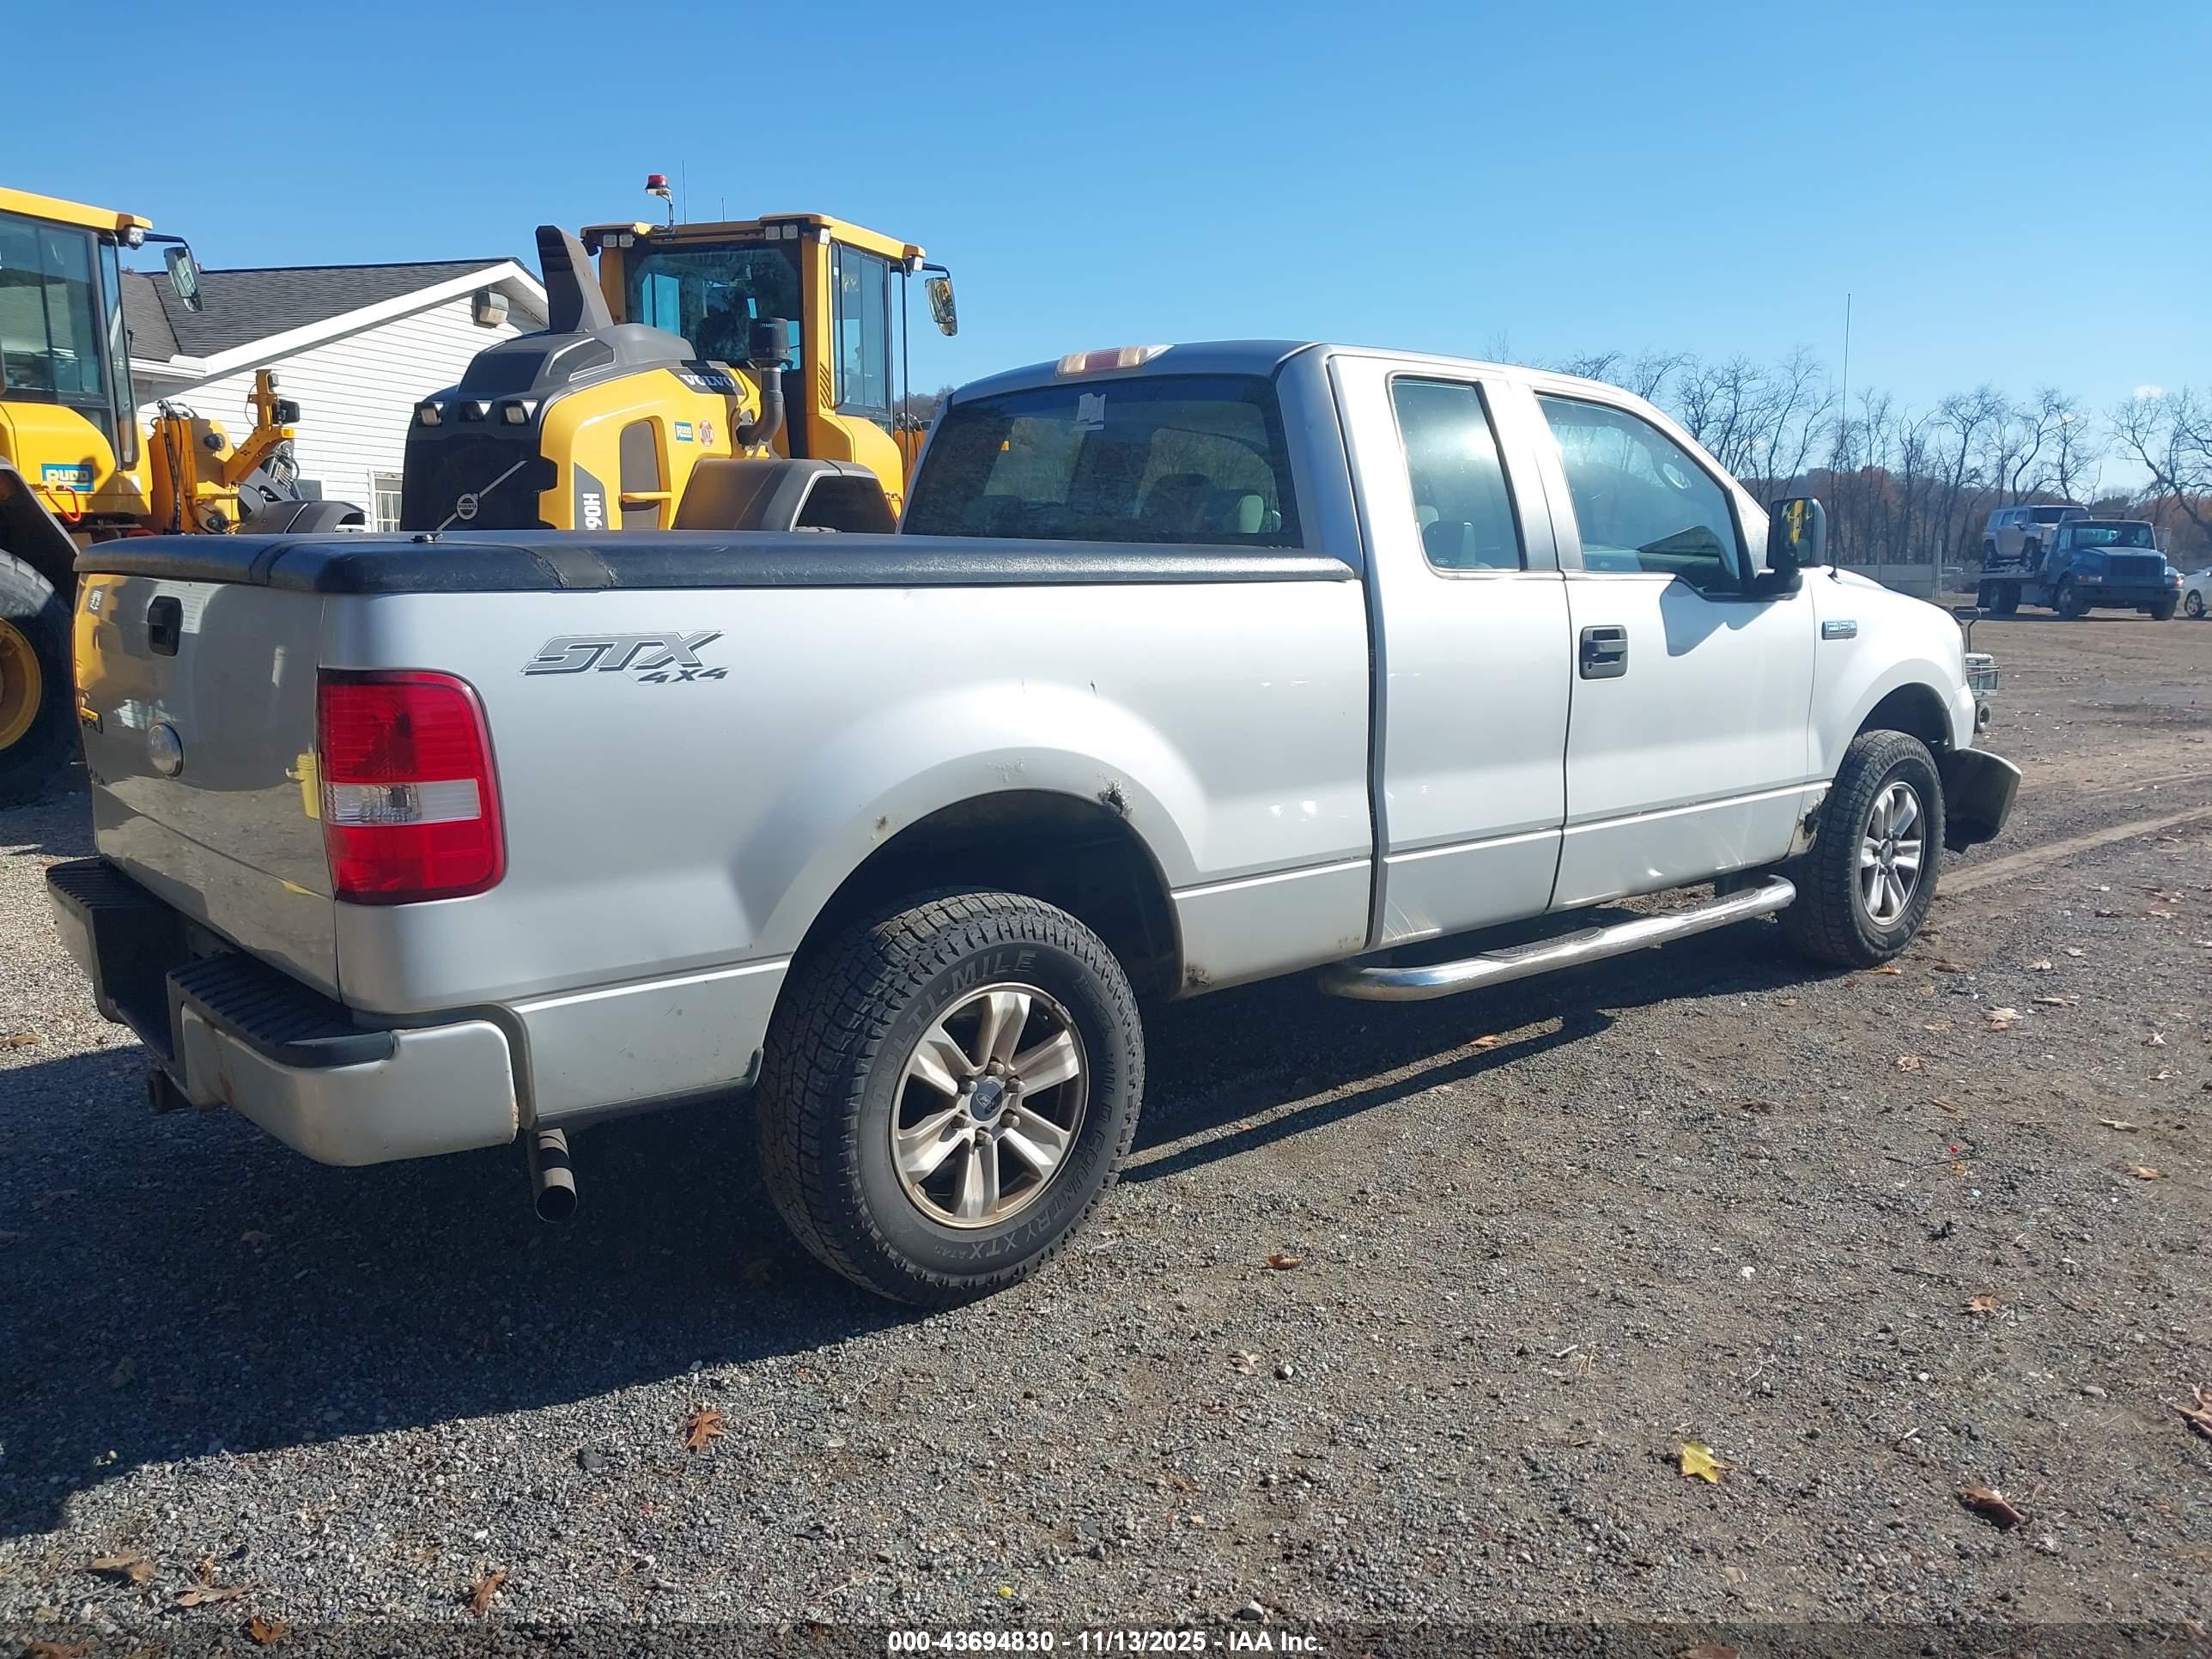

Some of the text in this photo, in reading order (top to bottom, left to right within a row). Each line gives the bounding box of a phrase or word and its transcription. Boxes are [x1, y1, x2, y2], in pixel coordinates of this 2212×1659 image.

[679, 374, 736, 386] VOLVO
[46, 469, 89, 490] RUDD
[582, 493, 603, 531] 90H
[520, 631, 726, 676] STX
[968, 1231, 1018, 1261] XTX
